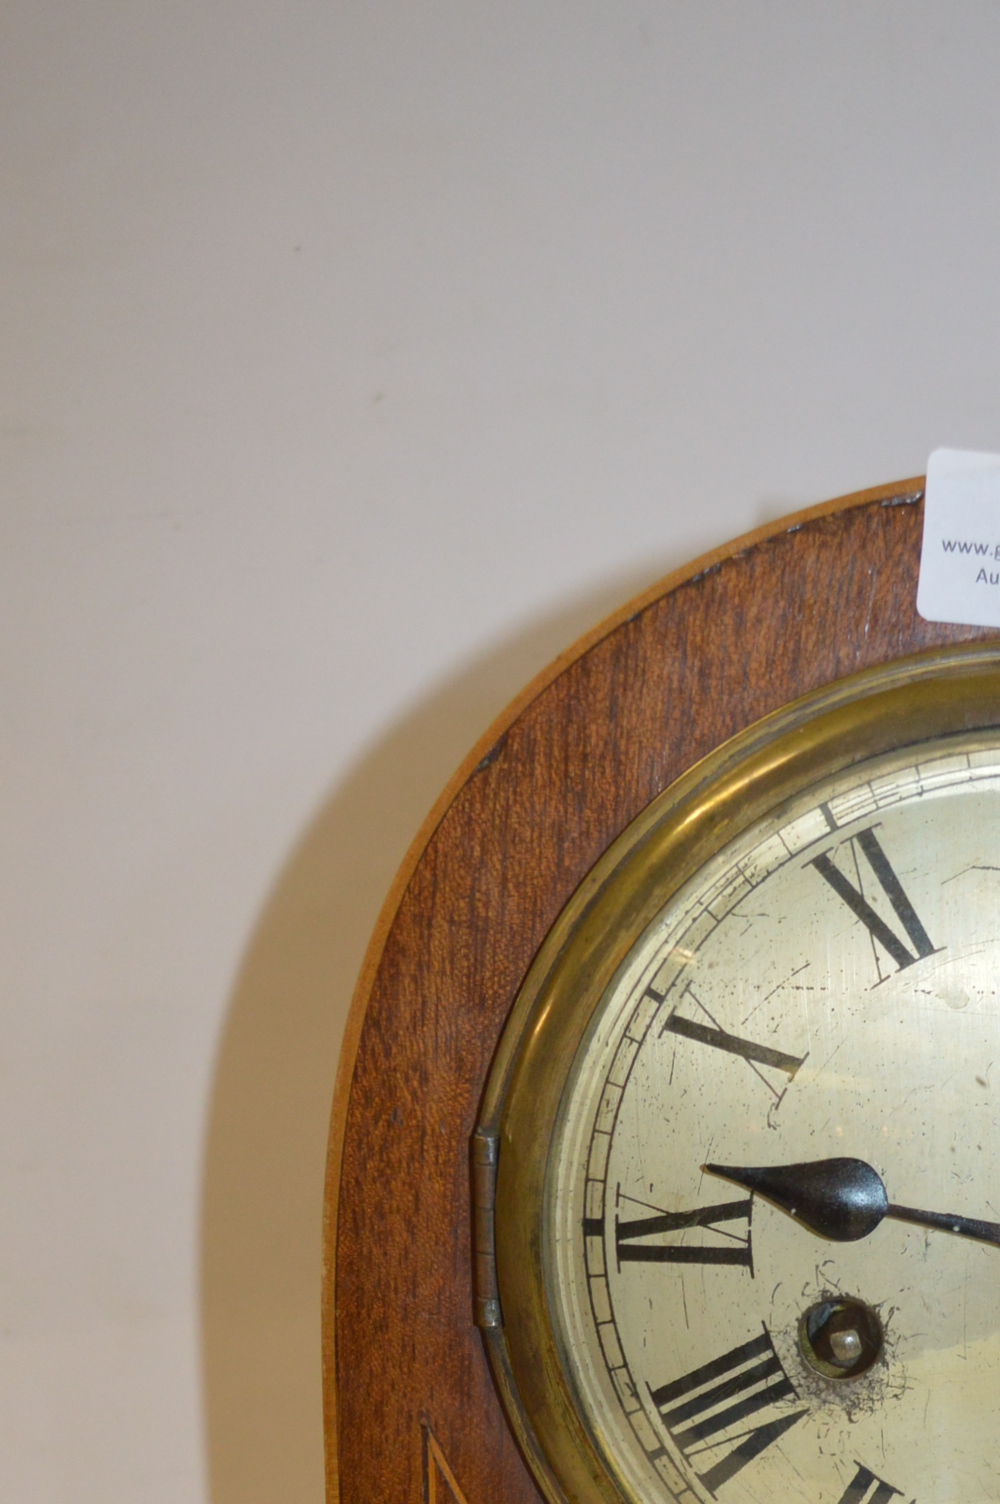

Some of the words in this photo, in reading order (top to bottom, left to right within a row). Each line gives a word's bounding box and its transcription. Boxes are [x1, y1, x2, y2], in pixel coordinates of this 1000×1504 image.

[801, 822, 948, 990] XI
[657, 979, 810, 1111] X
[615, 1181, 755, 1279] IX
[645, 1320, 810, 1501] VIII
